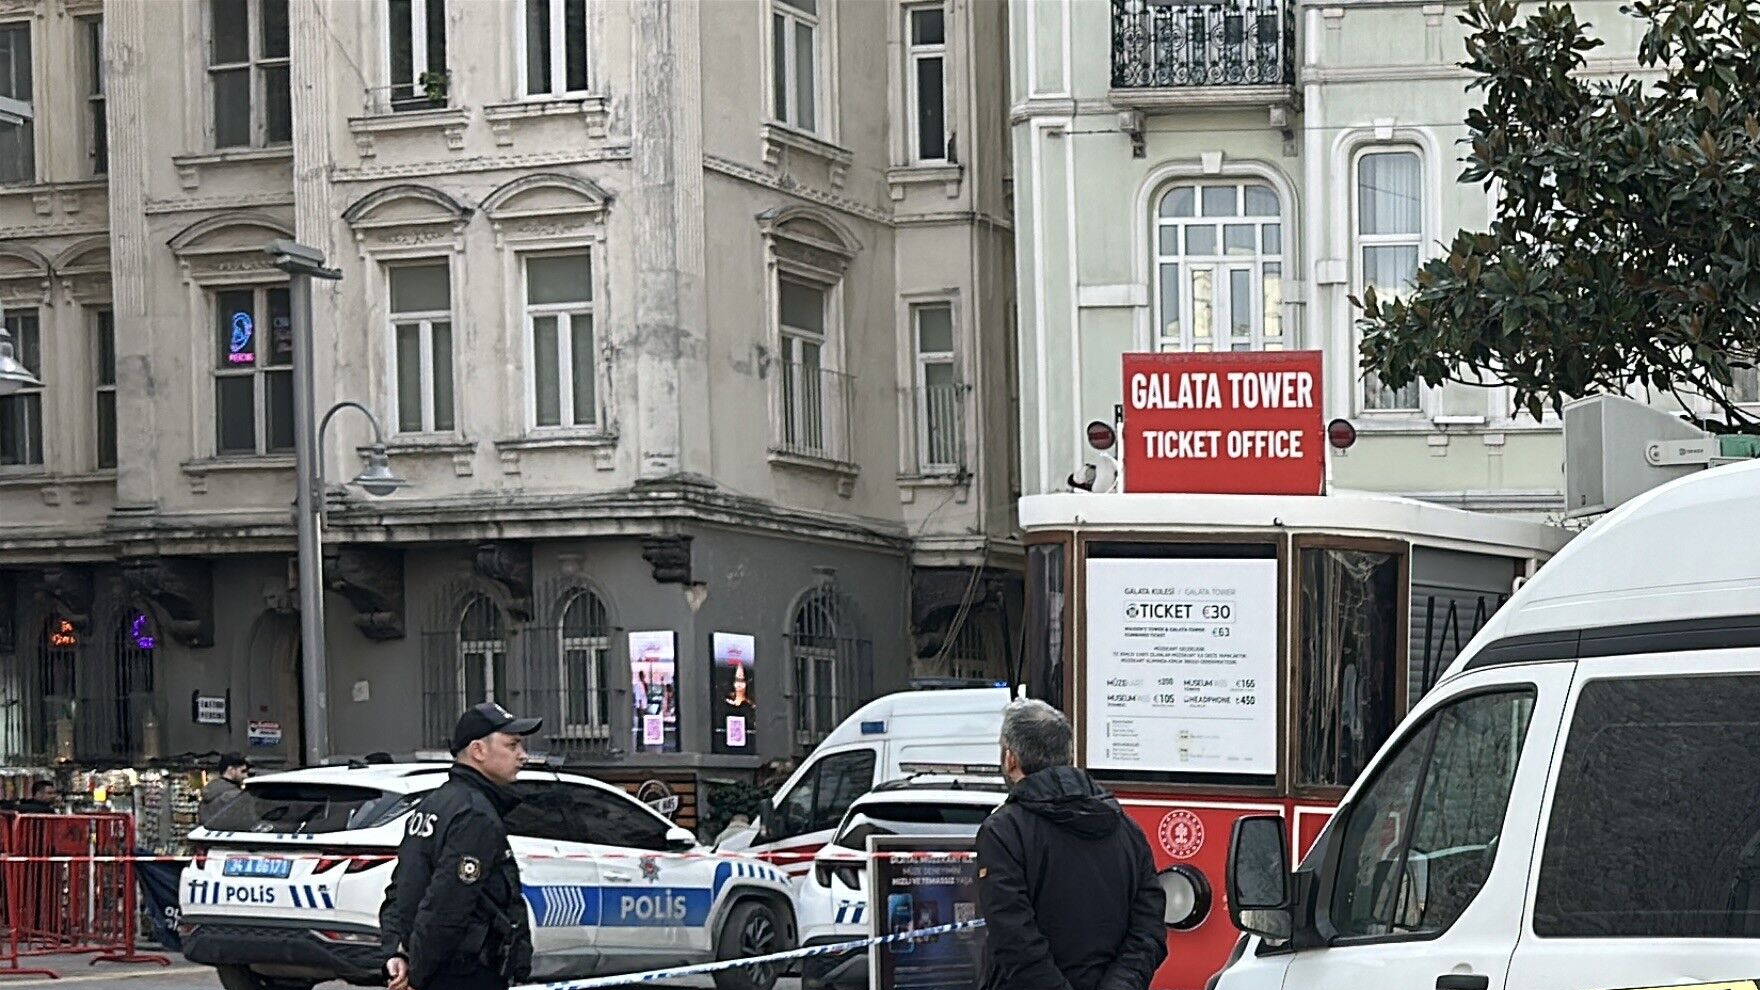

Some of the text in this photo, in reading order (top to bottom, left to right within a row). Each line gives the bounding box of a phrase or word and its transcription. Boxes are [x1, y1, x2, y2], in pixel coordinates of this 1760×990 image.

[1131, 371, 1314, 410] GALATA TOWER
[1142, 430, 1304, 459] TICKET OFFICE
[1139, 604, 1231, 619] TICKET €30
